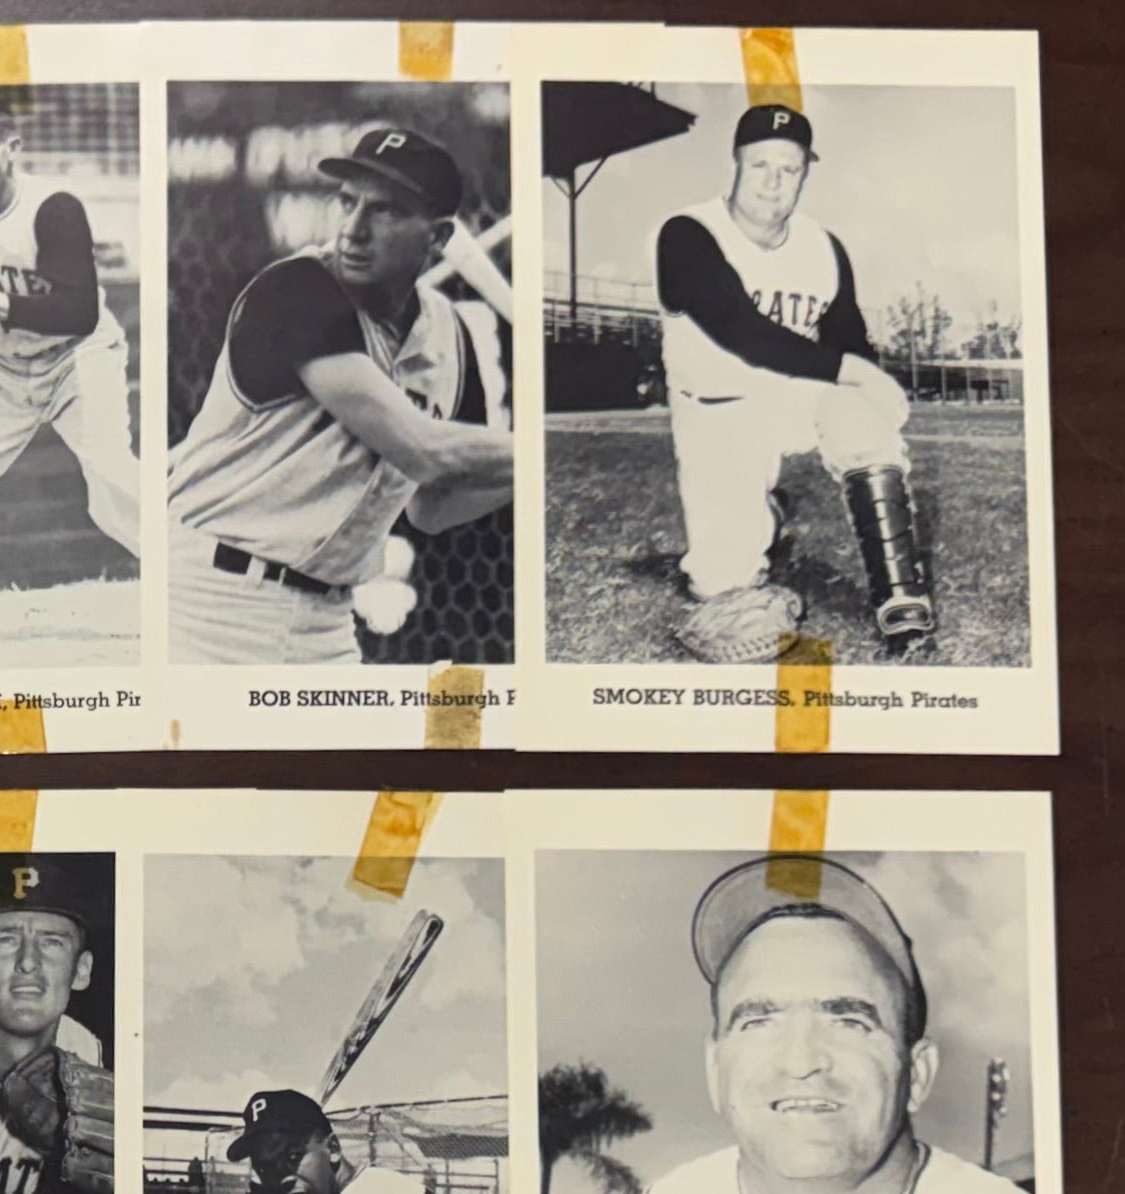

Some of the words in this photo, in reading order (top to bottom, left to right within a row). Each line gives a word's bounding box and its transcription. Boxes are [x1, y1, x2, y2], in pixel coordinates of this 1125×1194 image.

[772, 111, 791, 130] P
[376, 132, 408, 155] P
[13, 691, 110, 711] Pittsburgh
[248, 690, 291, 707] BOB
[400, 690, 501, 710] Pittsburgh
[592, 688, 686, 705] SMOKEY
[803, 690, 904, 711] Pittsburgh
[911, 692, 979, 709] Pirates
[11, 867, 40, 900] P
[251, 1098, 267, 1122] P
